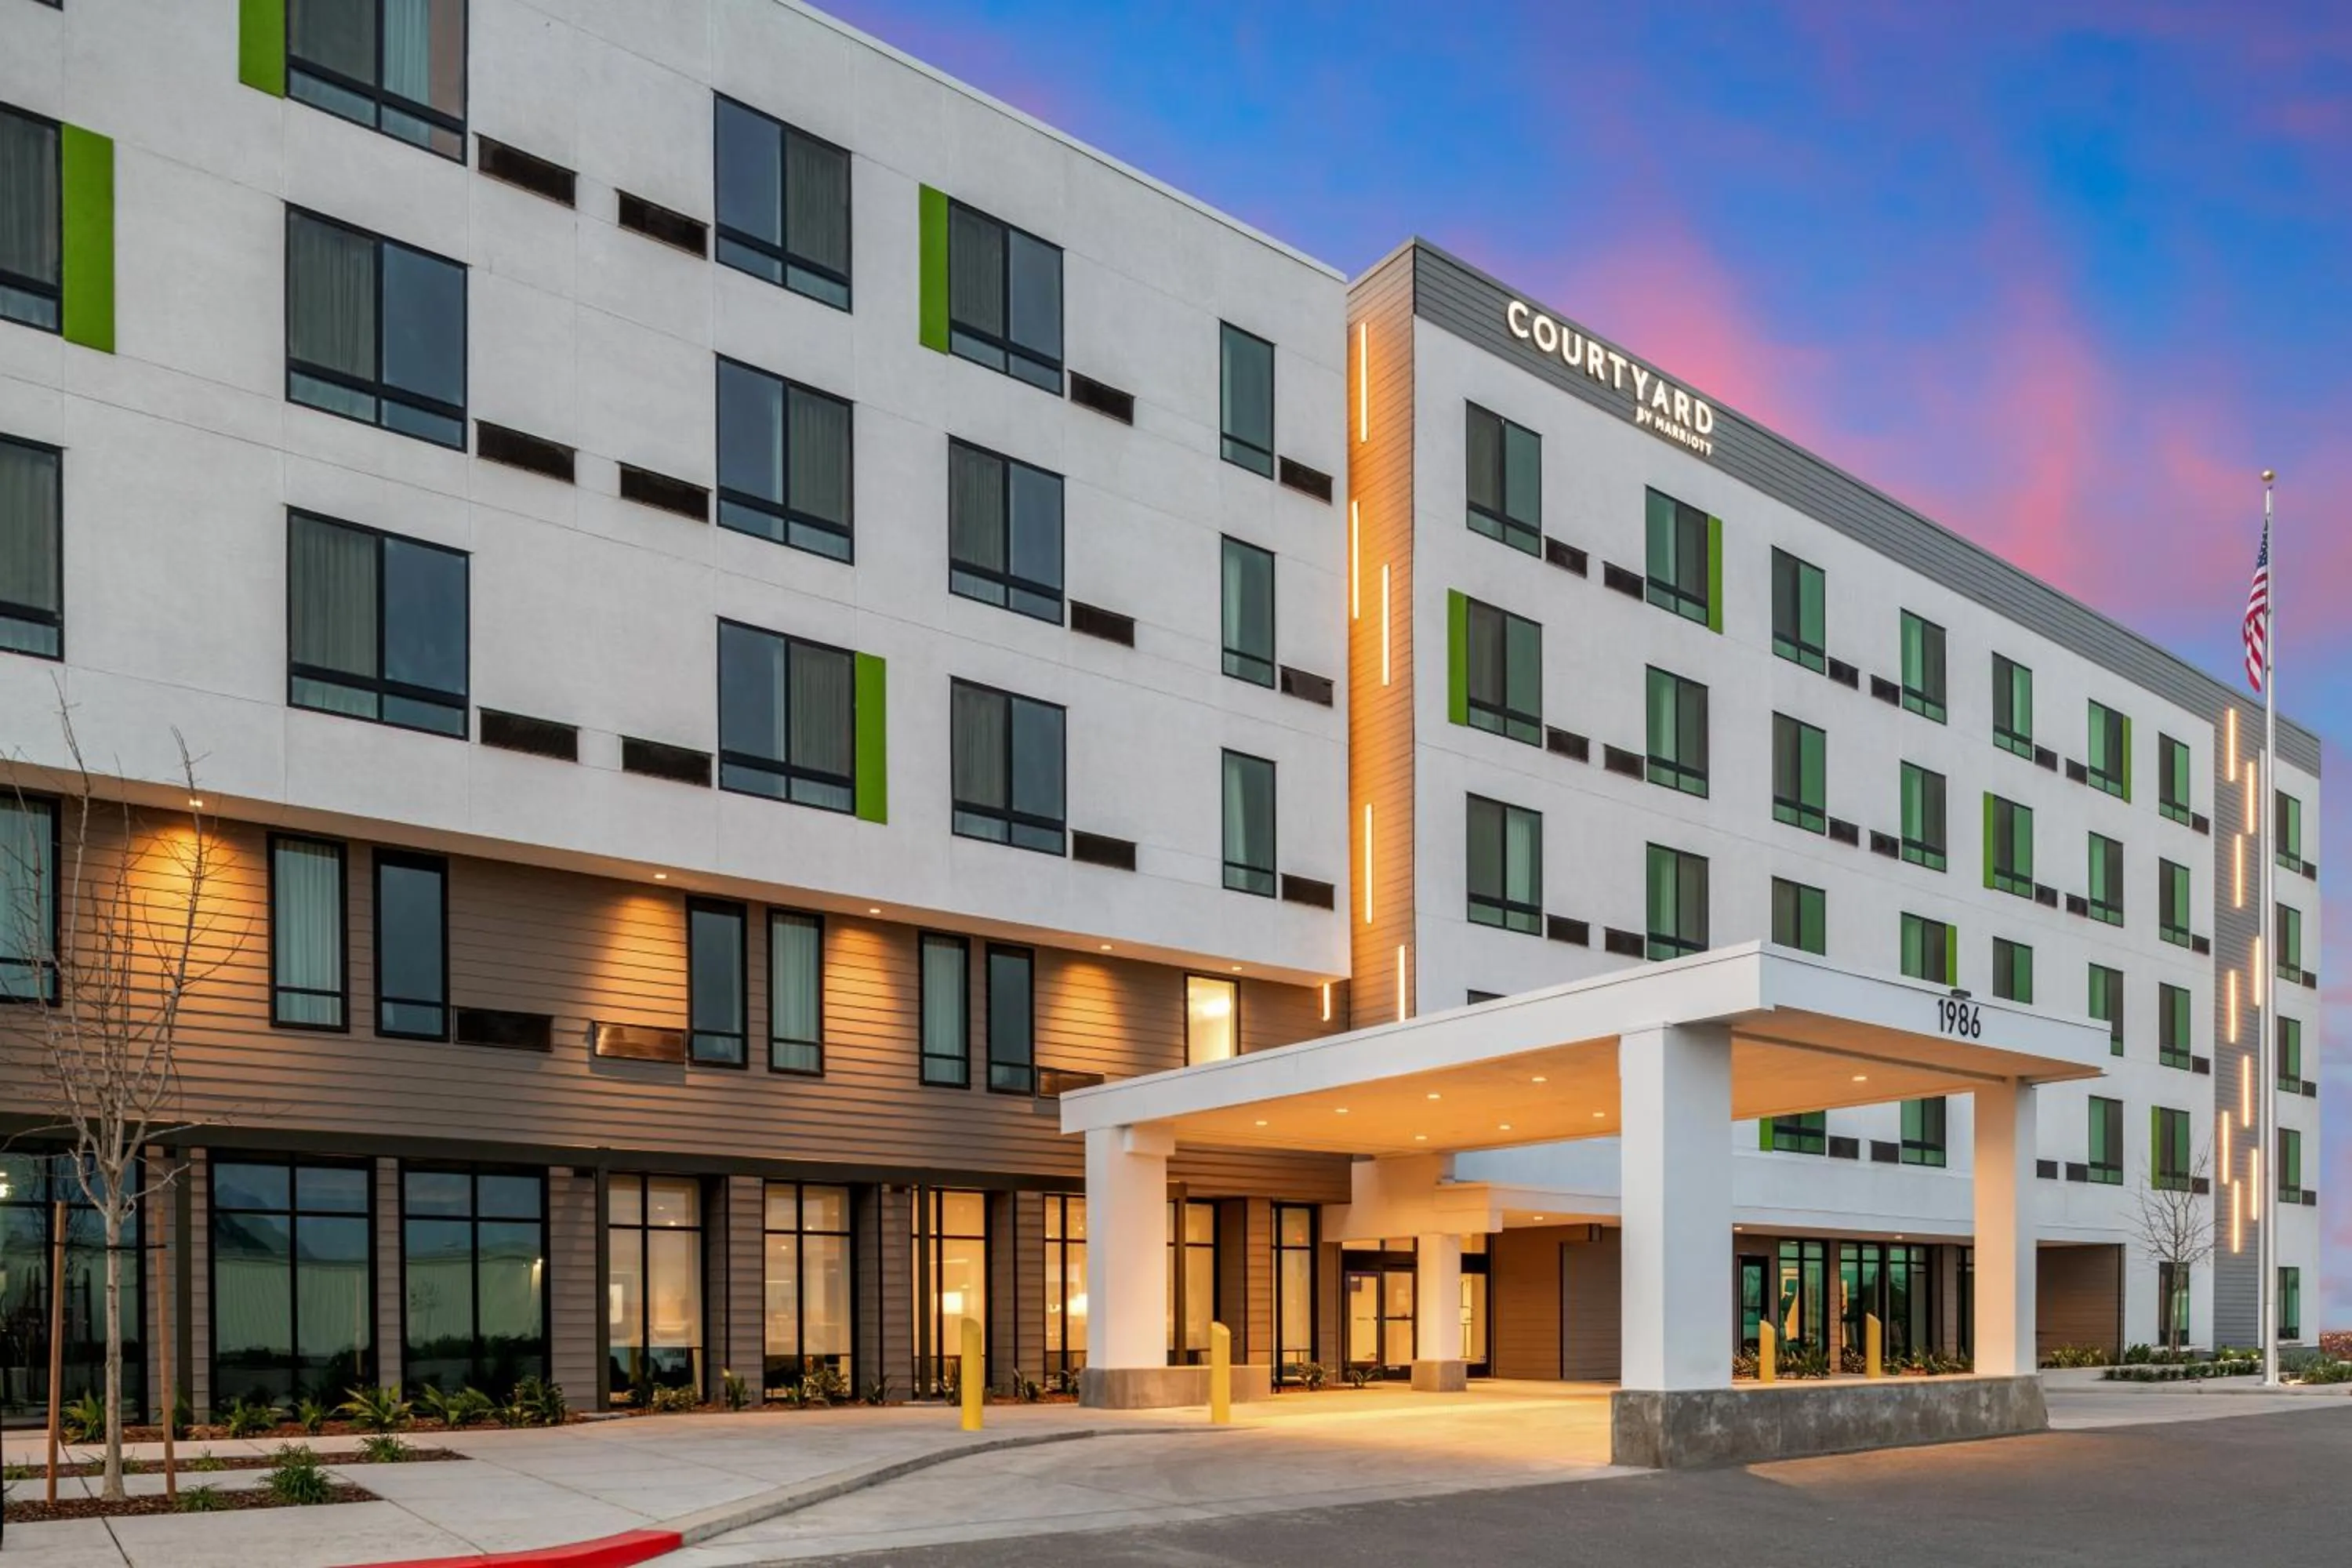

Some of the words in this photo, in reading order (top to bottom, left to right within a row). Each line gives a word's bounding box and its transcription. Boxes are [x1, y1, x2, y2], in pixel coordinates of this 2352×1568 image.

[1507, 301, 1712, 434] COURTYARD
[1635, 406, 1652, 423] BY
[1655, 416, 1712, 456] MARRIOTT
[1938, 999, 1981, 1039] 1986
